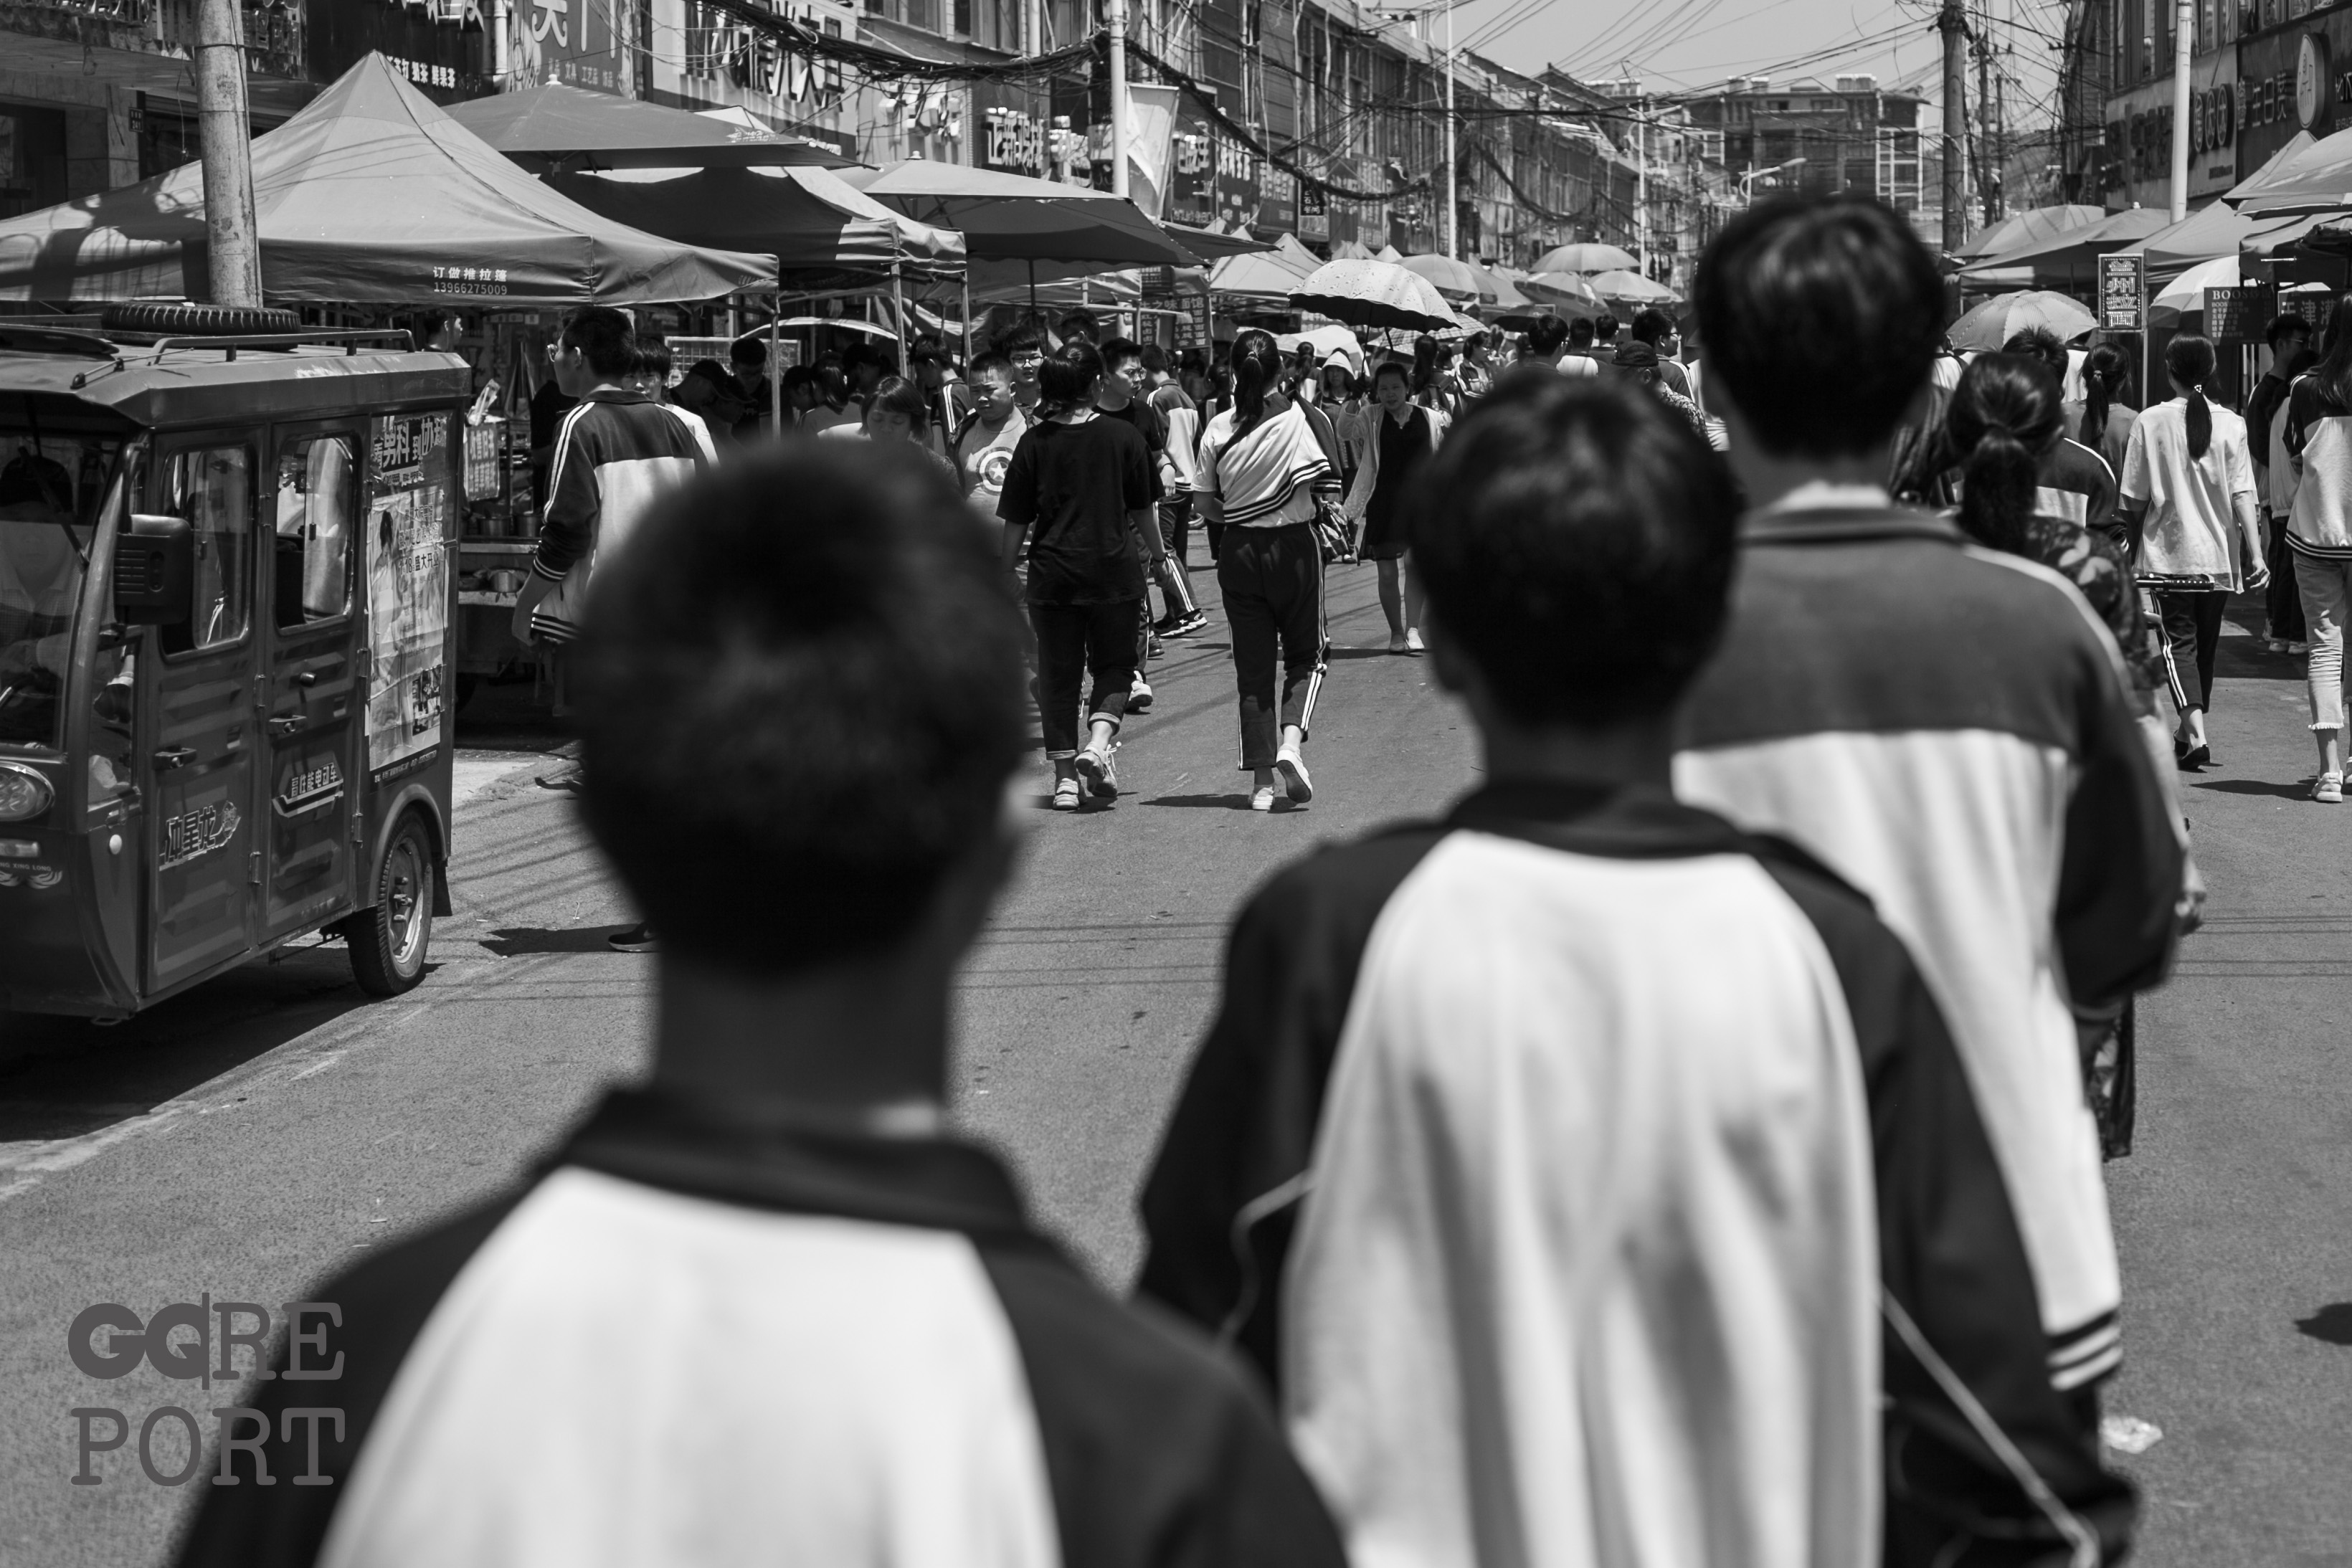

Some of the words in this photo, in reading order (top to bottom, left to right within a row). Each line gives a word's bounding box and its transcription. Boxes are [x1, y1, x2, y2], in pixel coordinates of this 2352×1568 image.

[432, 266, 508, 282] 订做推拉篷
[434, 282, 508, 295] 13966275009
[2105, 260, 2138, 328] 兰州拉面
[291, 764, 337, 798] 高性能电动车
